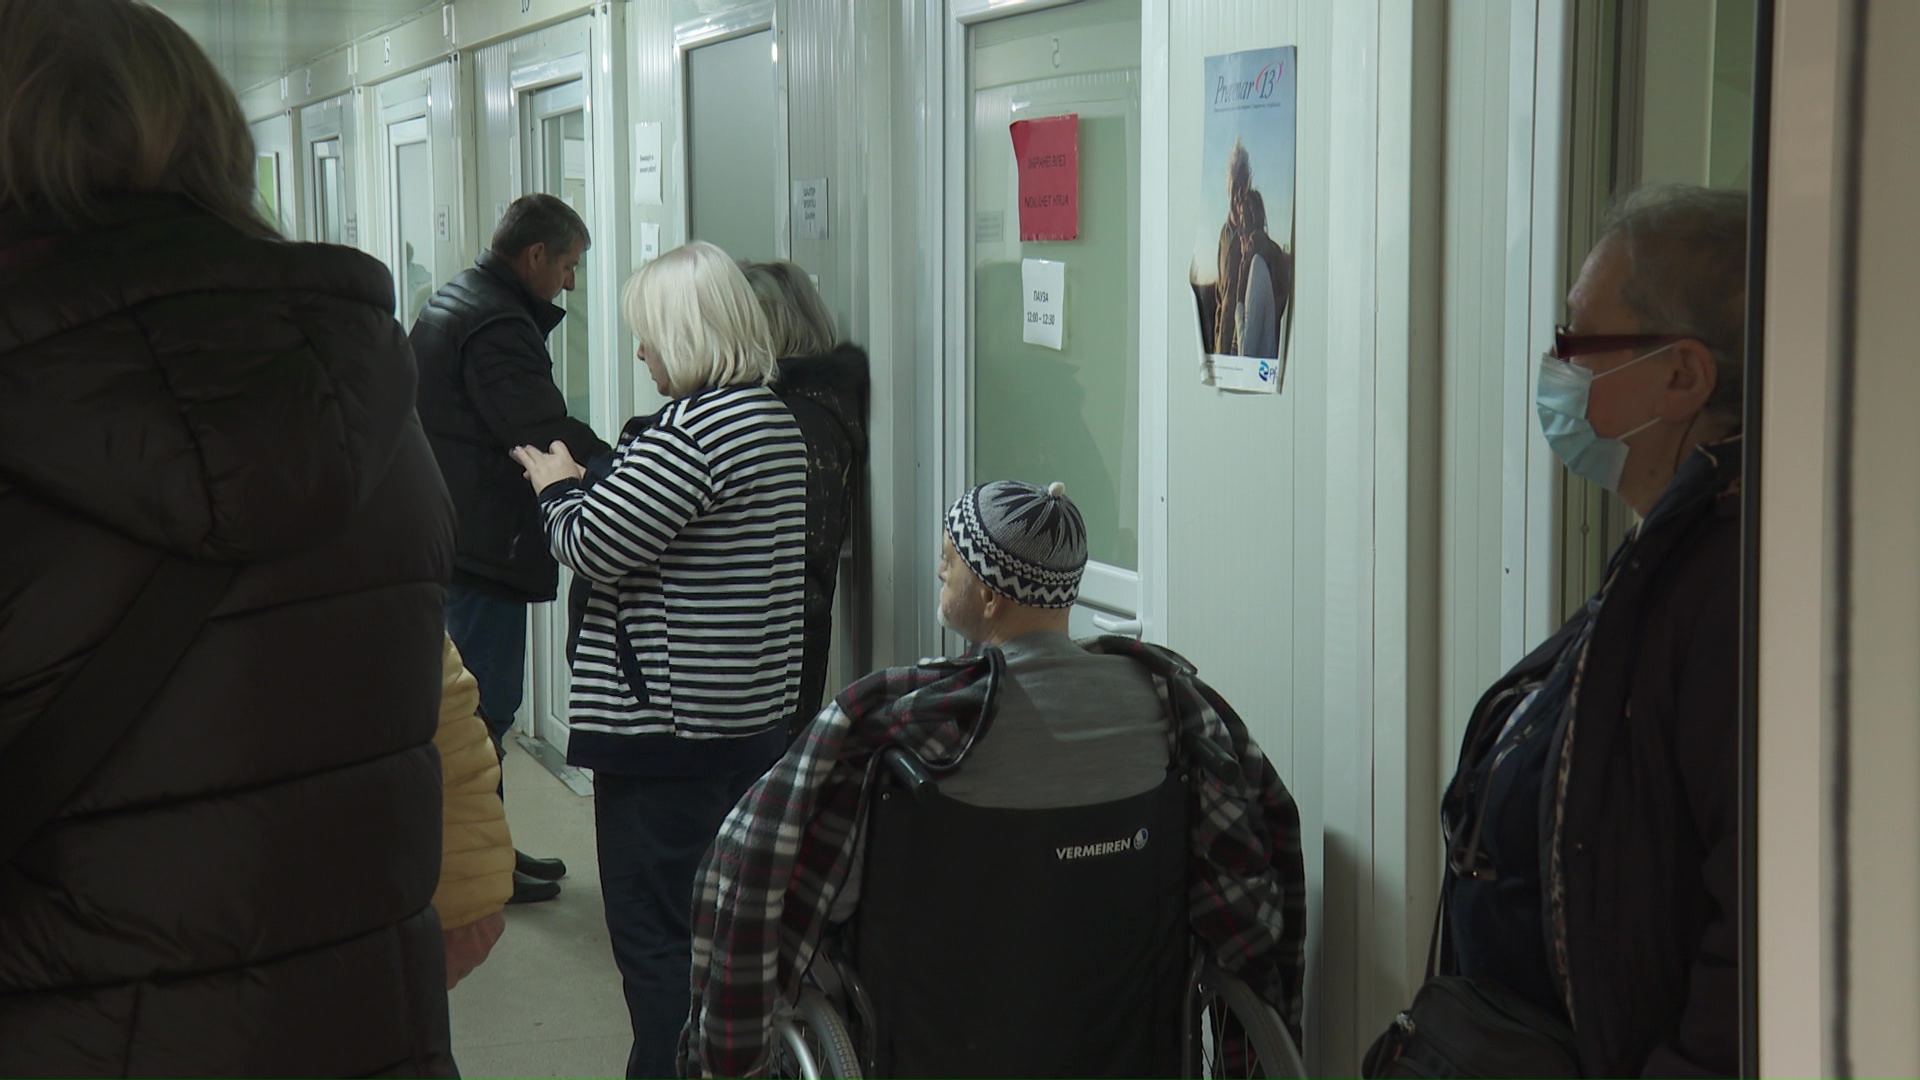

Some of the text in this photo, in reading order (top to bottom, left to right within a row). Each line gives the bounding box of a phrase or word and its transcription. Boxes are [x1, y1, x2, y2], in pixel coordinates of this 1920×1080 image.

[1259, 69, 1276, 99] 13
[1033, 289, 1049, 303] ПАУЗА
[1027, 310, 1039, 323] 12:00
[1042, 312, 1055, 326] 12:30
[1056, 838, 1131, 860] VERMEIREN
